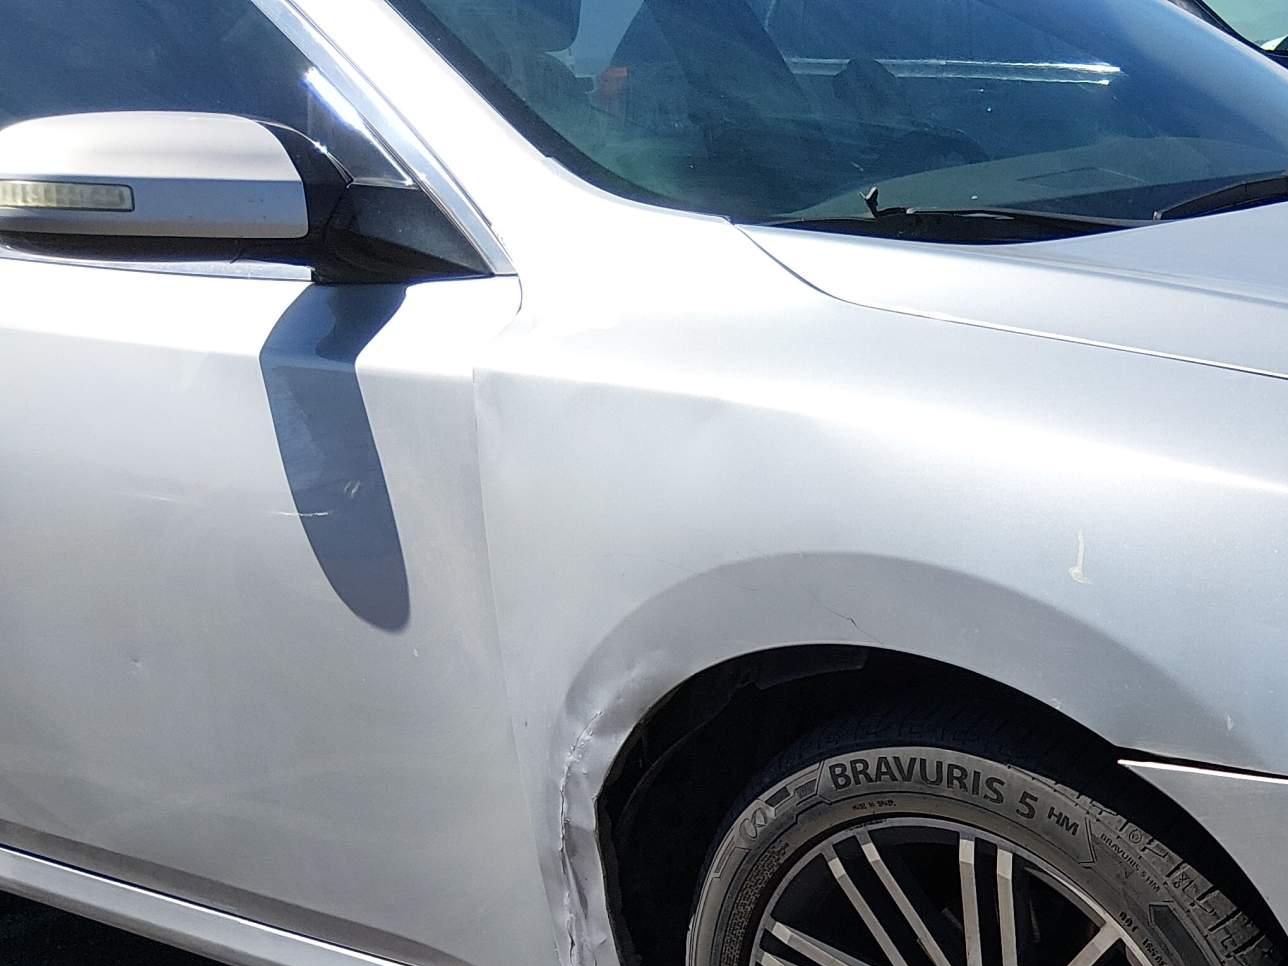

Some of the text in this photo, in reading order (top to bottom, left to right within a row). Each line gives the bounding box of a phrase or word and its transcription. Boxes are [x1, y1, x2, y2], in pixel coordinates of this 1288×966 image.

[828, 756, 1079, 836] BRAVURIS 5 HM
[1101, 833, 1140, 871] BRAVURIS
